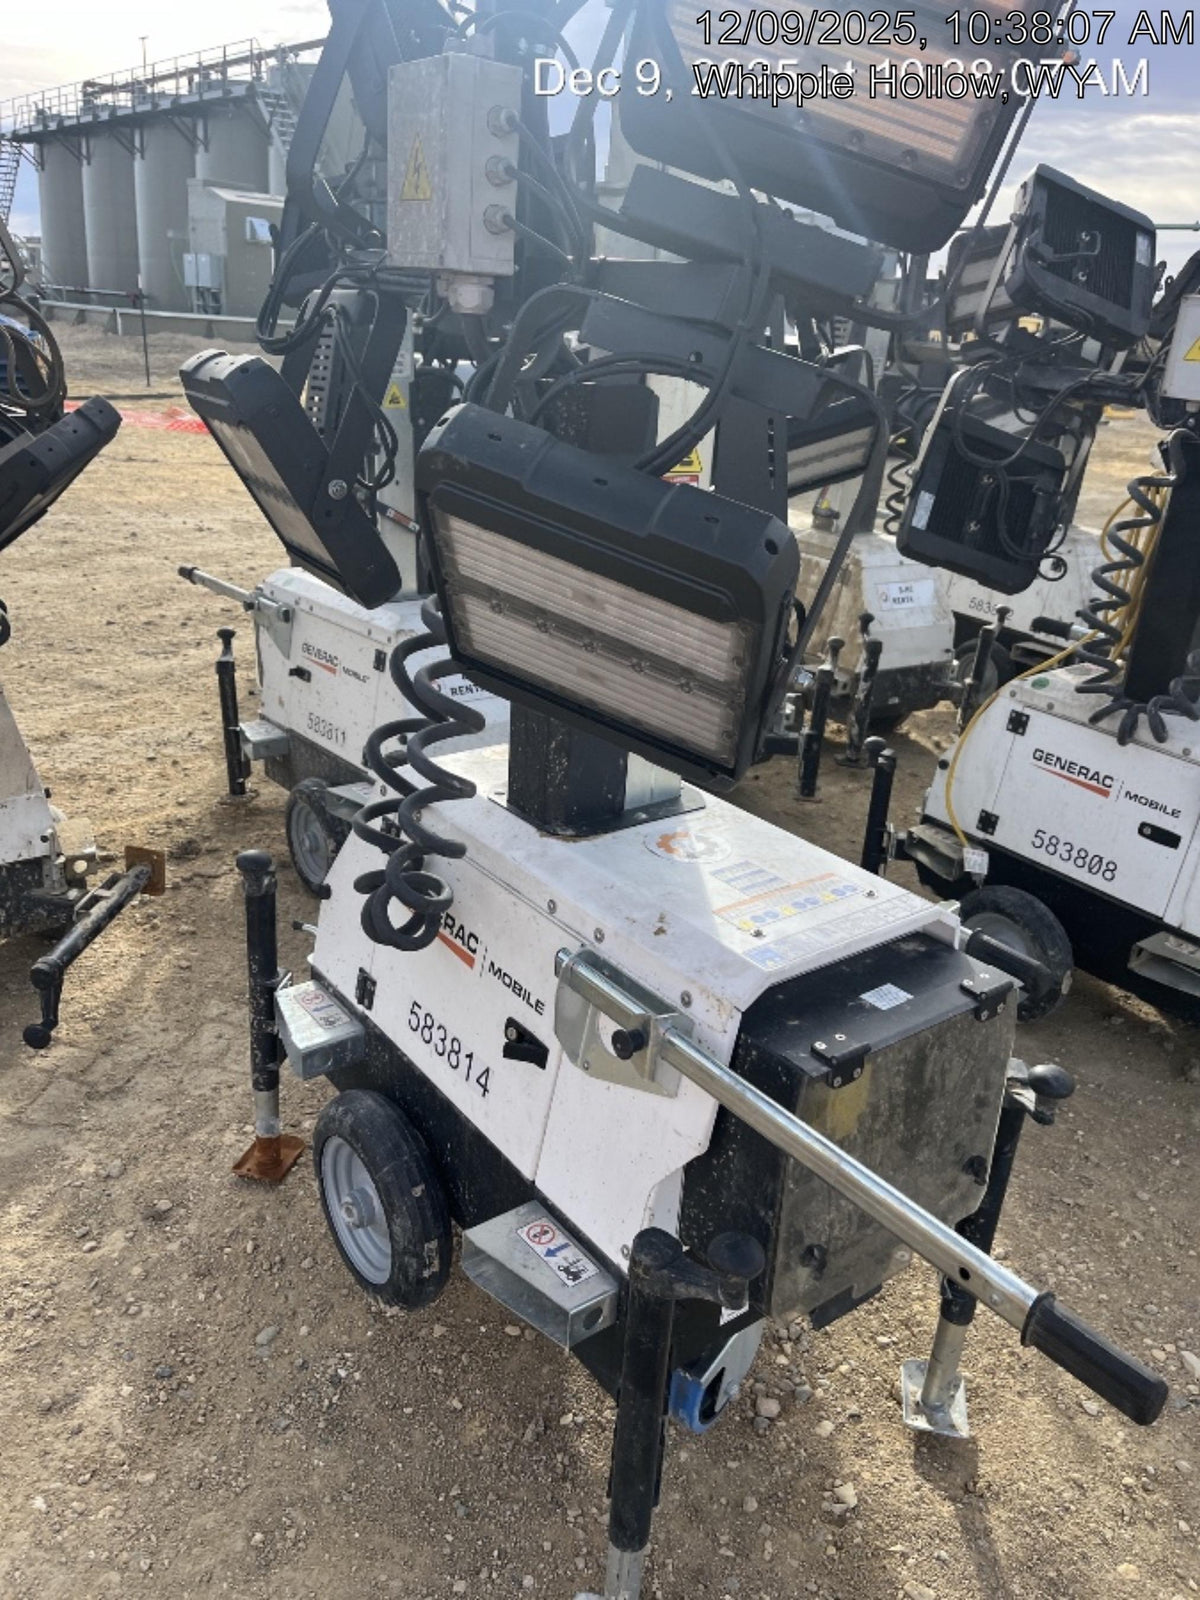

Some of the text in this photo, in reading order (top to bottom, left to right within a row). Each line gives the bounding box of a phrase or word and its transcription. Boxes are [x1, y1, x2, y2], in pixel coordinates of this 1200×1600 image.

[307, 712, 347, 744] 583811
[1032, 748, 1182, 819] GENERAC MOBILE
[1031, 829, 1118, 882] 583808
[488, 960, 545, 1016] MOBILE
[408, 1000, 491, 1098] 583814
